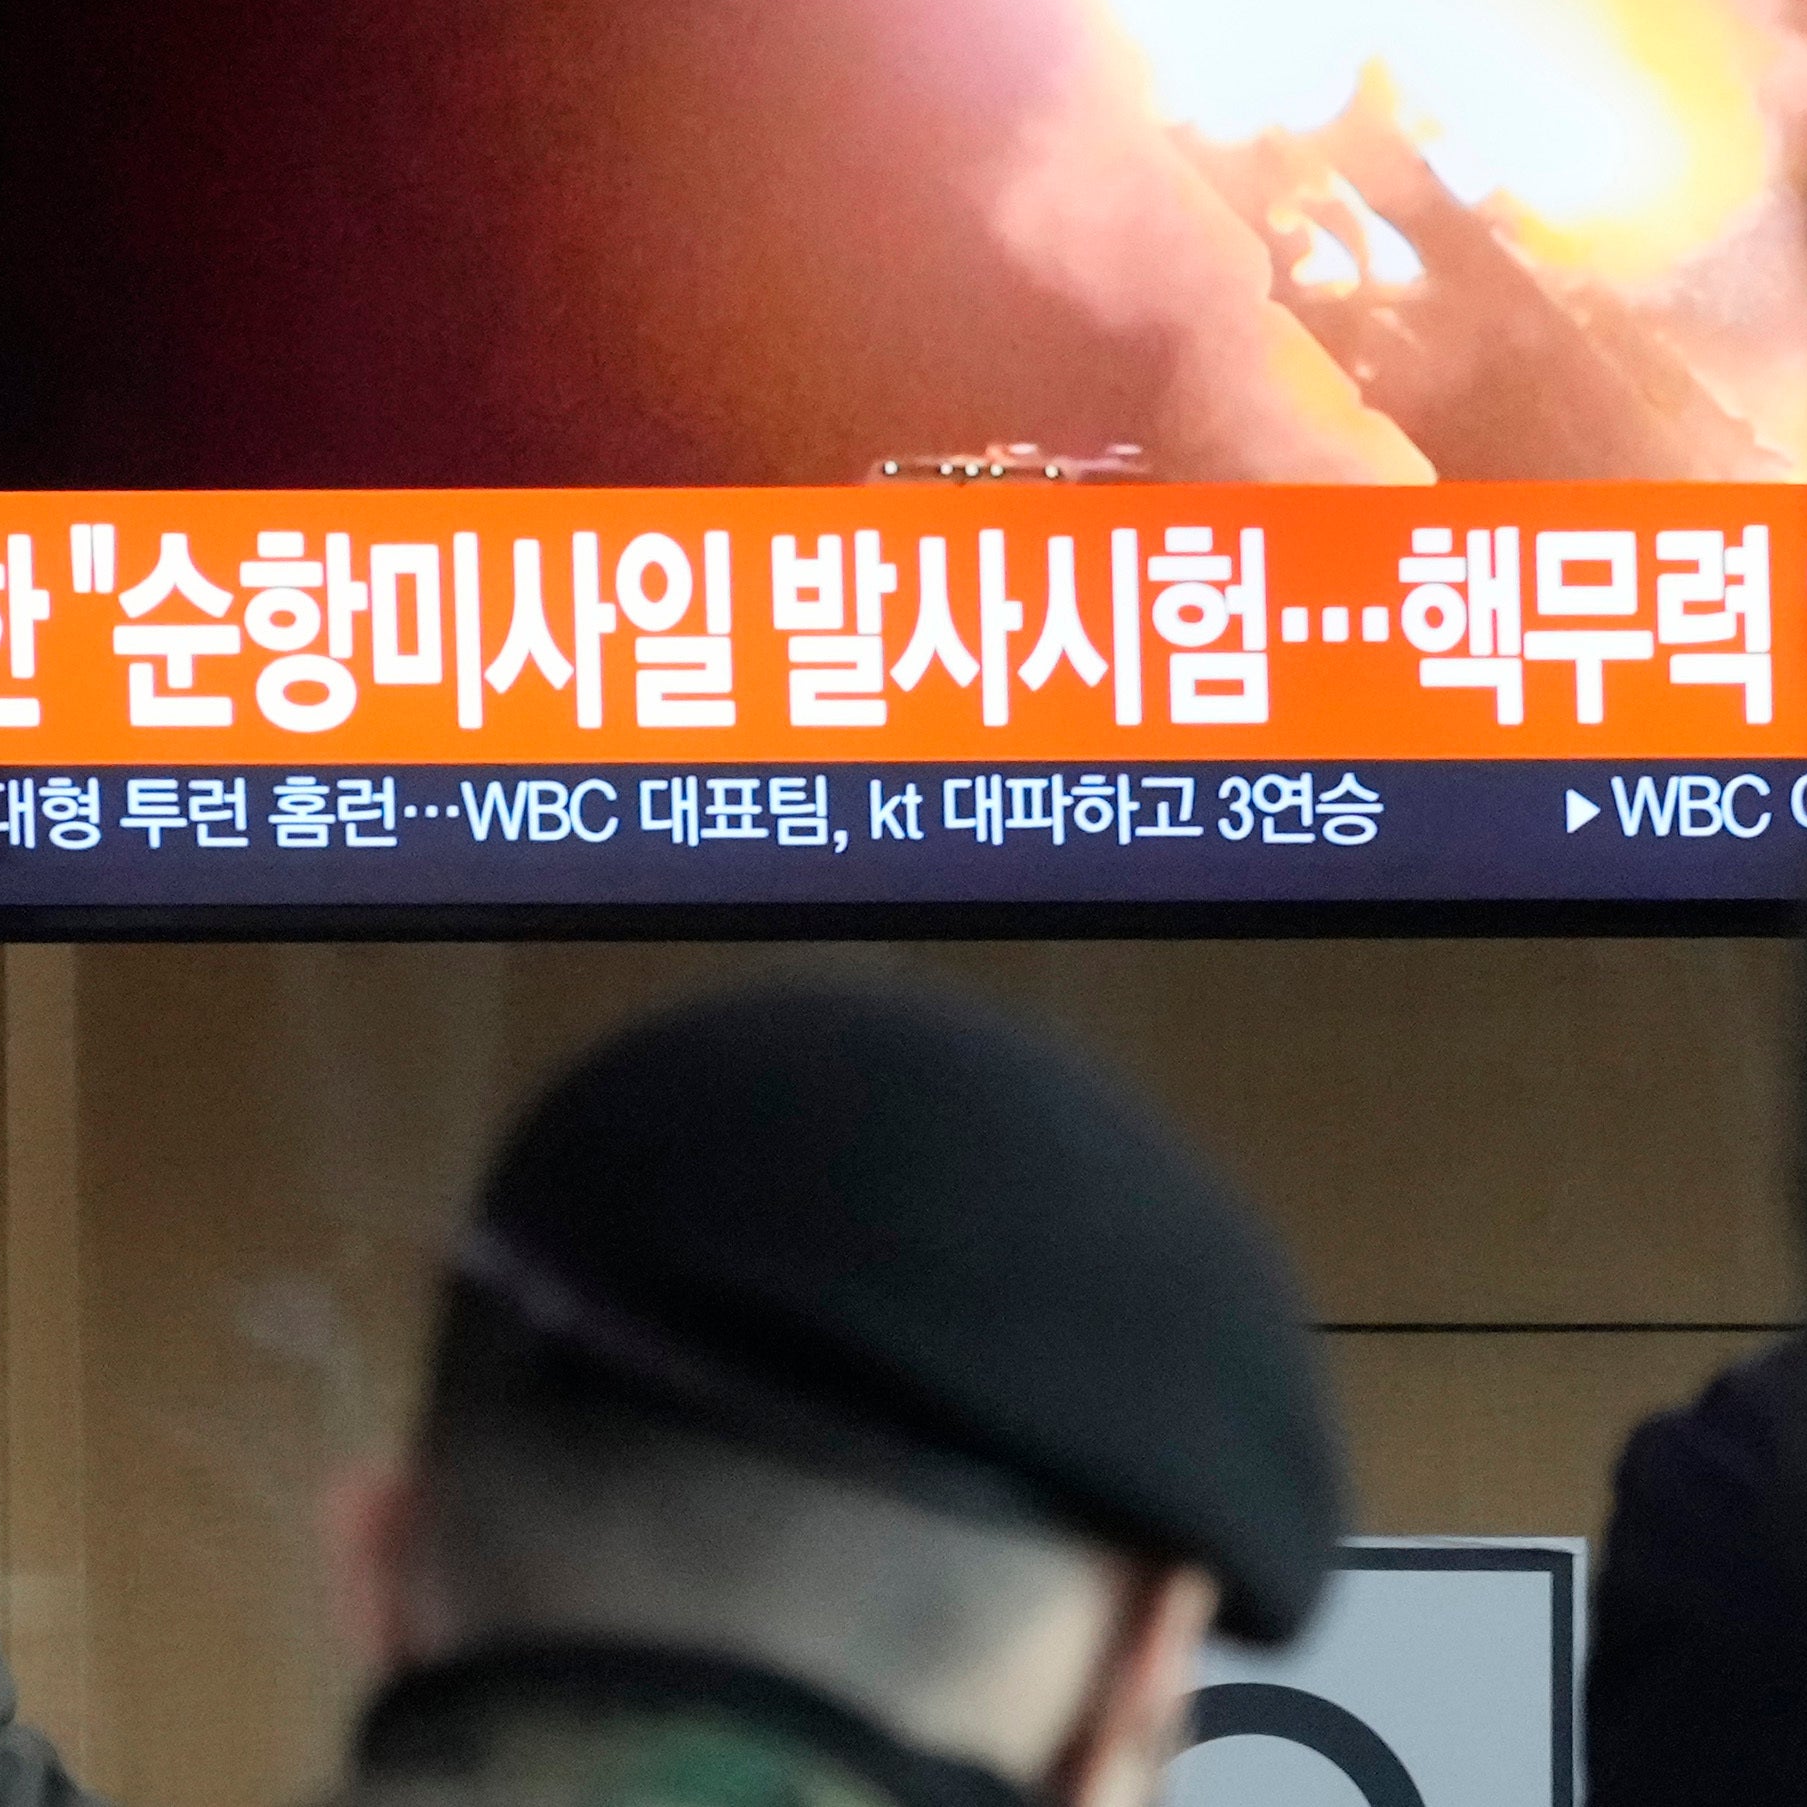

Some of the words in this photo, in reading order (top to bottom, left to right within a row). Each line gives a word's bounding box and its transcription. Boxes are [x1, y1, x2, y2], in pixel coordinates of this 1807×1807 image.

[69, 522, 738, 733] "순항미사일
[118, 776, 250, 849] 투런
[638, 773, 846, 854] 대표팀,
[869, 778, 925, 841] kt
[942, 772, 1205, 847] 대파하고
[1217, 771, 1385, 846] 3연승
[1609, 773, 1772, 840] WBC
